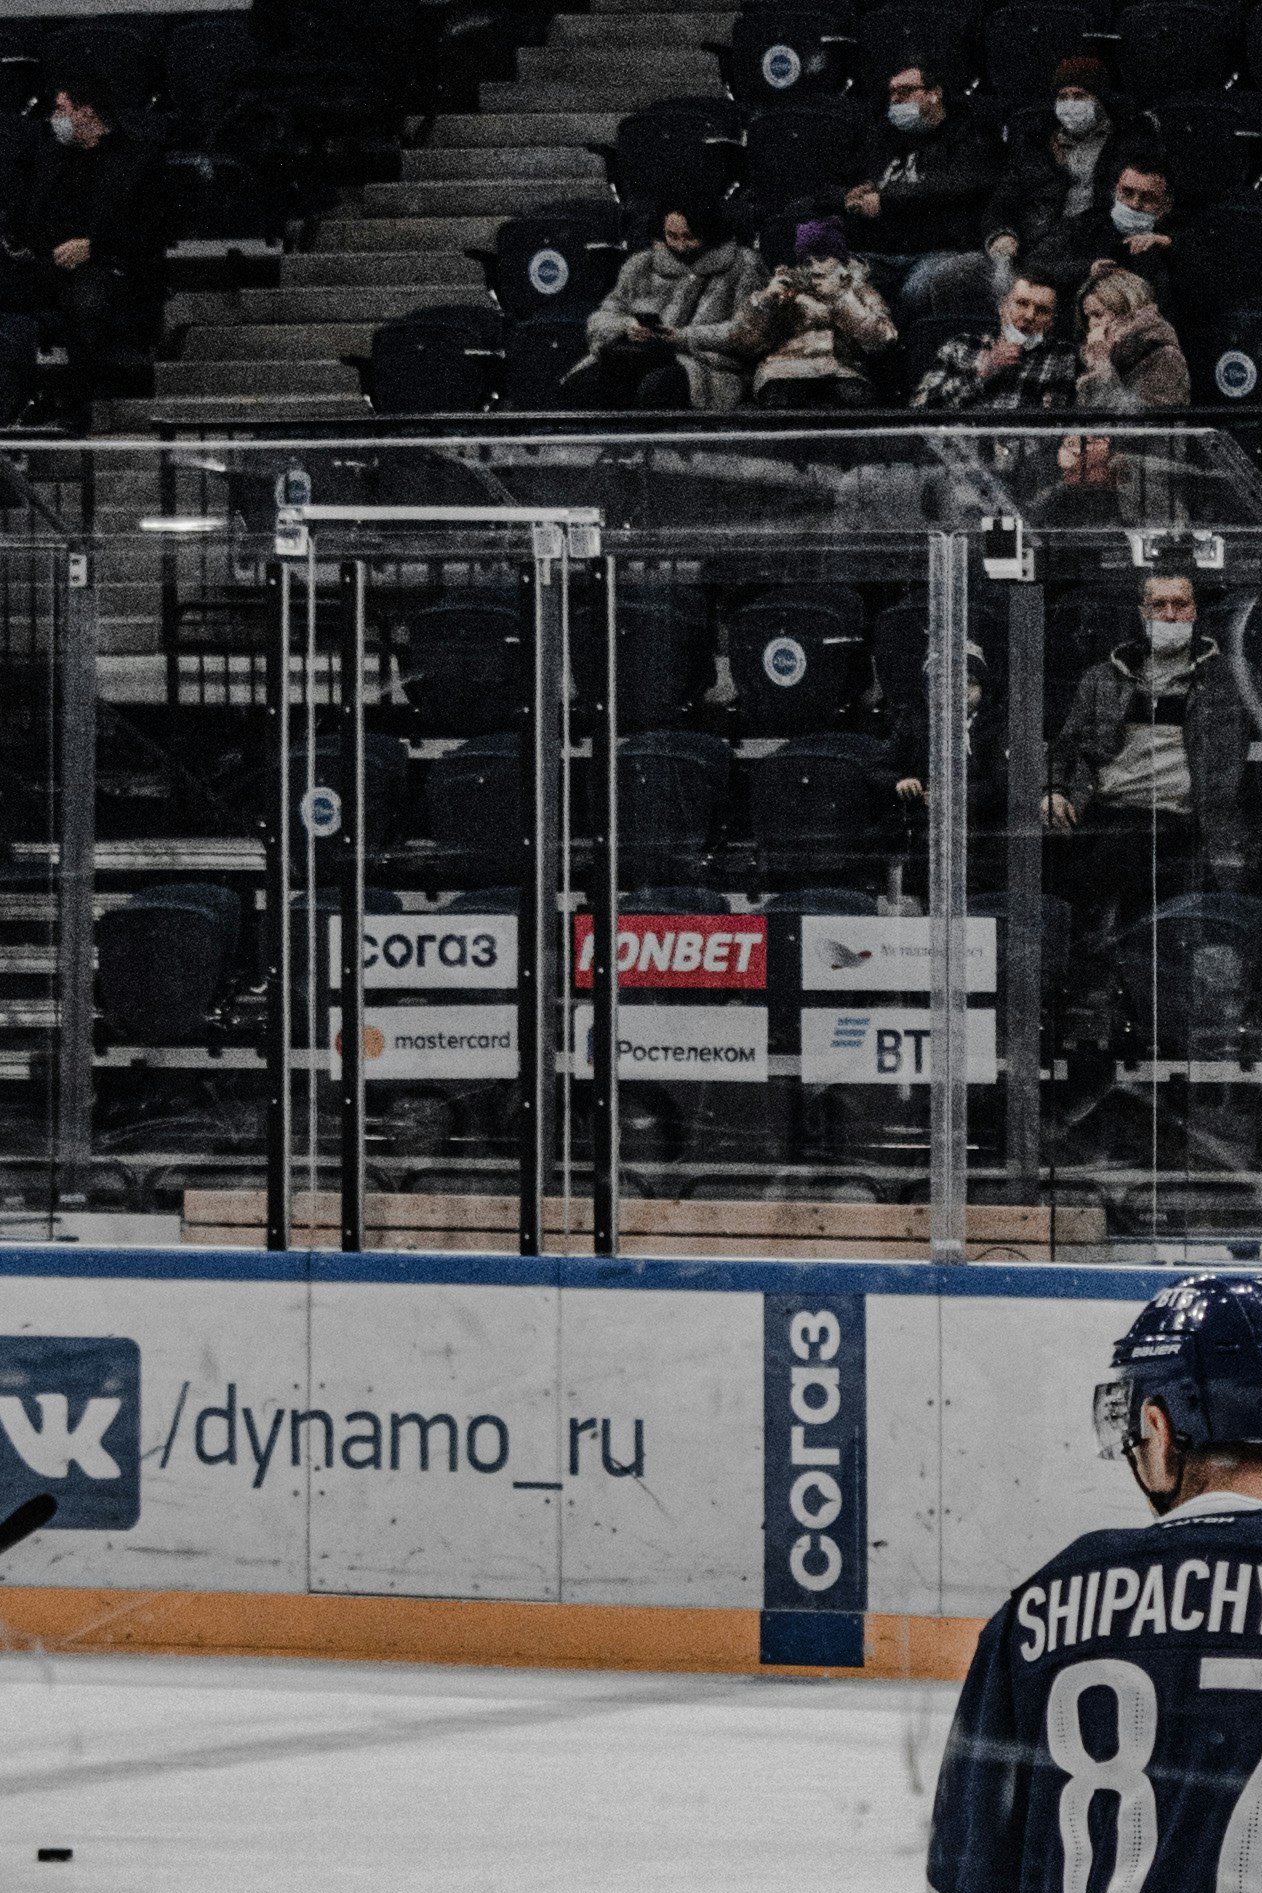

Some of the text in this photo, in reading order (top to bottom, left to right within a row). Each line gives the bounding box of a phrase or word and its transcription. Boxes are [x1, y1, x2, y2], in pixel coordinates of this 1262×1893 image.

[394, 1030, 512, 1050] mastercard
[616, 1039, 756, 1063] Ростелеком
[159, 1380, 645, 1490] /dynamo_ru
[789, 1310, 842, 1591] согаз
